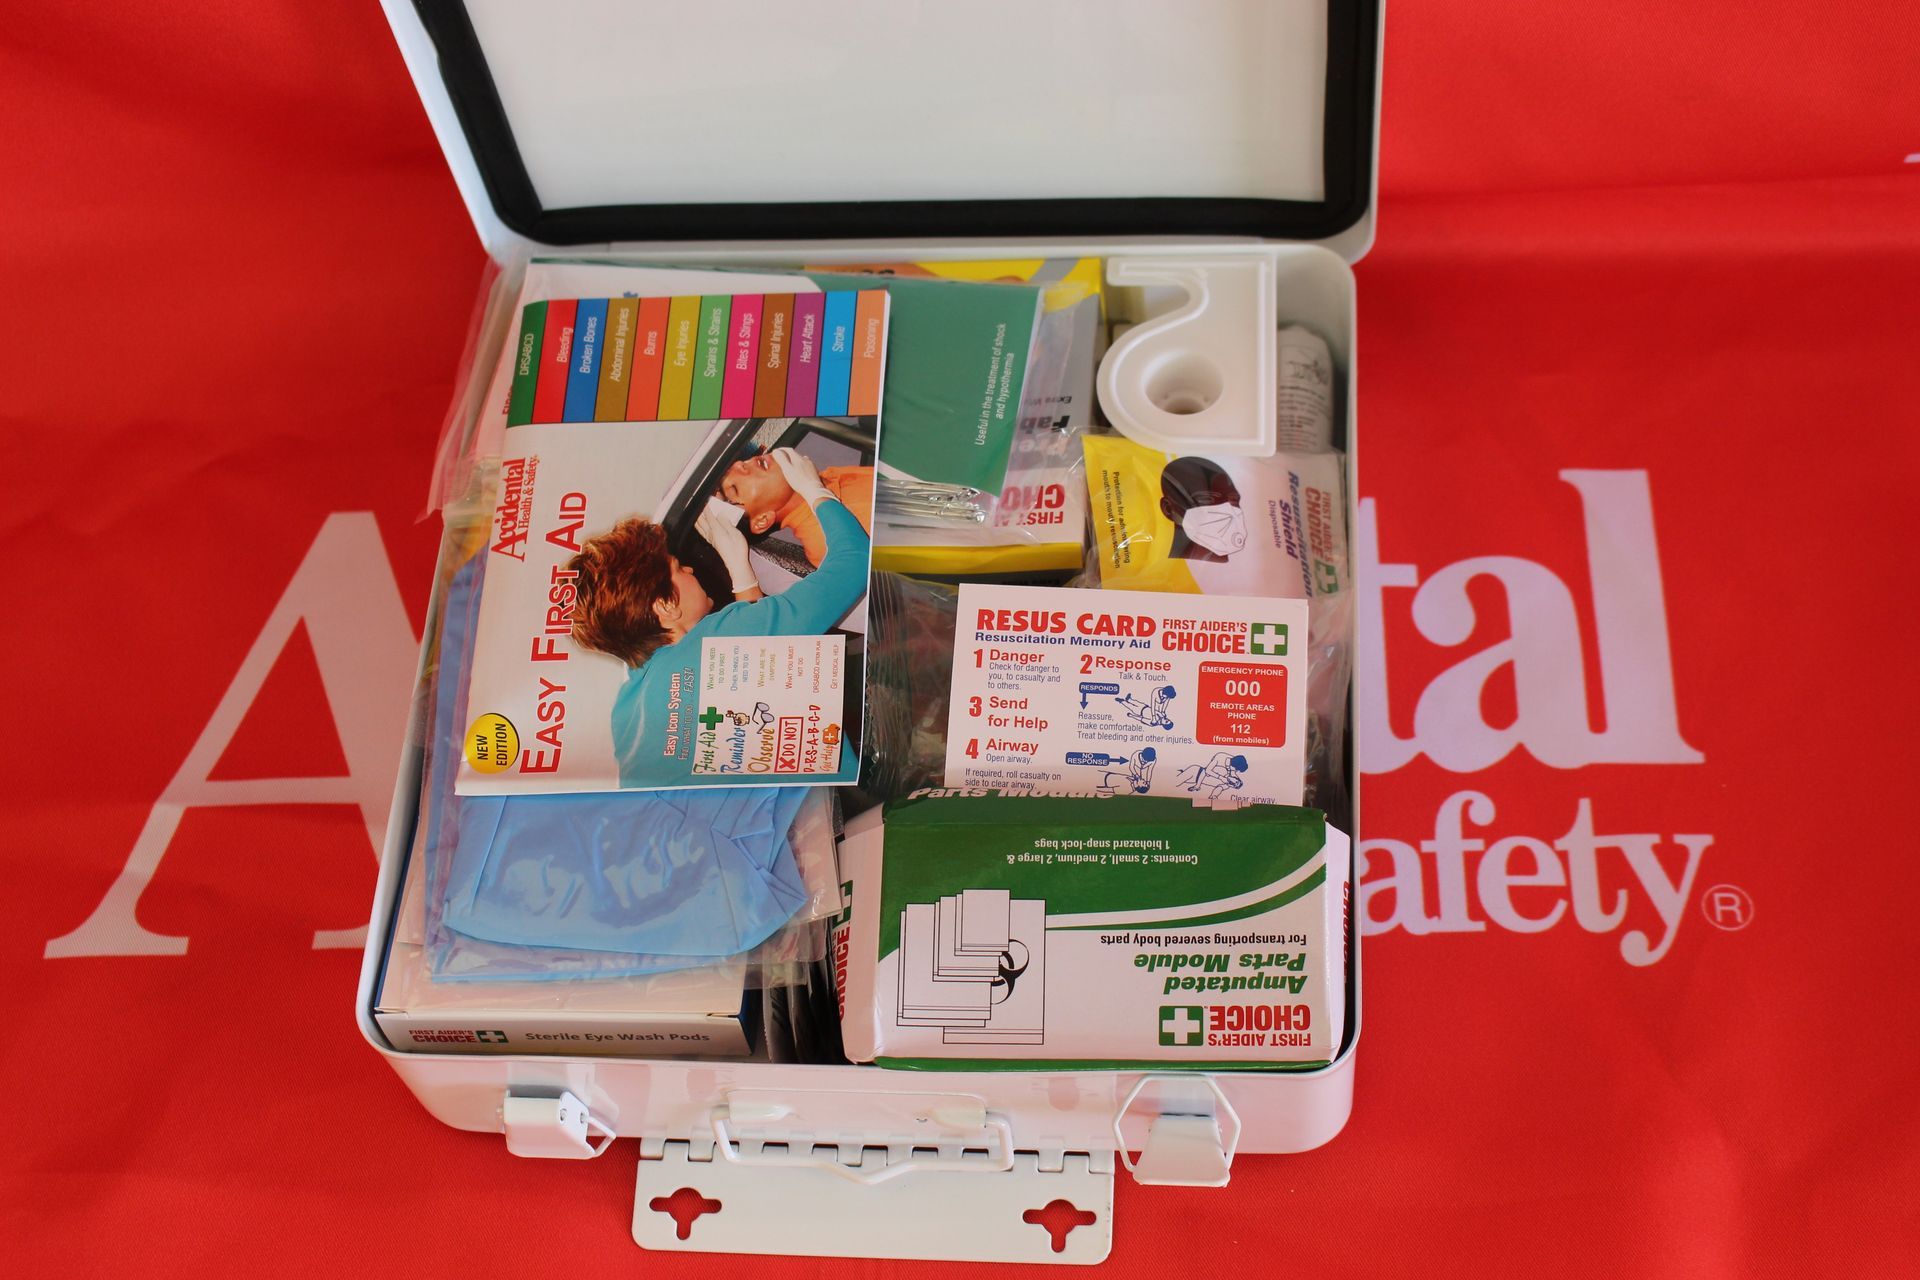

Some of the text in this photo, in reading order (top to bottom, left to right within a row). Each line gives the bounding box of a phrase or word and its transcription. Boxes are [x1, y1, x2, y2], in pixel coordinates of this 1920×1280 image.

[556, 327, 574, 363] Bleeding
[579, 316, 597, 374] Broken Bones
[610, 307, 630, 382] Abdominal Injuries
[643, 331, 657, 356] Burns
[674, 320, 690, 366] Eye Injuries
[704, 308, 722, 378] Sprains & Strains
[736, 313, 754, 370] Bites & Stings
[767, 312, 784, 369] Spinal Injuries
[800, 313, 815, 363] Heart Attack
[832, 326, 845, 352] Stroke
[863, 318, 880, 359] Poisoning
[519, 333, 535, 376] DRSABCD
[974, 323, 1006, 446] Useful in the treatment of shock
[994, 352, 1015, 420] and hypothermia
[522, 487, 534, 495] &
[490, 457, 529, 562] Accidental
[518, 495, 532, 530] Health
[1322, 491, 1331, 520] FIRST
[1268, 500, 1281, 549] Disposable
[1279, 499, 1299, 560] Shield
[1288, 470, 1312, 598] Resuscitation
[1305, 487, 1324, 559] CHOICE
[519, 491, 587, 774] EASY FIRST AID
[976, 609, 1157, 637] RESUS CARD
[1162, 619, 1247, 632] FIRST AIDER'S
[975, 632, 1151, 649] Resuscitation Memory Aid
[1161, 631, 1246, 654] CHOICE
[973, 648, 1045, 668] 1 Danger
[989, 662, 1060, 674] Check for danger to
[1080, 654, 1171, 674] 2 Response
[988, 673, 1061, 683] you, to casualty and
[1118, 671, 1168, 682] Talk & Touch.
[1201, 666, 1284, 676] EMERGENCY PHONE
[996, 682, 1021, 690] others.
[1080, 684, 1118, 692] RESPONDS
[1225, 680, 1261, 697] 000
[663, 673, 682, 756] Easy Icon System
[969, 696, 1028, 717] 3 Send
[1078, 711, 1114, 722] Reassure,
[1210, 702, 1275, 712] REMOTE AREAS
[1227, 712, 1257, 720] PHONE
[987, 715, 1049, 732] for Help
[1077, 722, 1145, 733] make comfortable.
[1230, 724, 1251, 735] 112
[476, 734, 489, 760] NEW
[495, 723, 507, 766] EDITION
[782, 721, 798, 756] DO NOT
[803, 704, 821, 772] D-R-S-A-B-C-D
[965, 738, 1039, 759] 4 Airway
[1077, 731, 1194, 745] Treat bleeding and other injuries.
[1213, 735, 1269, 746] (from mobiles)
[692, 731, 720, 773] First Aid
[720, 727, 746, 773] Reminder
[747, 728, 775, 773] Observe
[985, 753, 1033, 765] Open airway.
[1067, 758, 1108, 766] RESPONSE
[965, 768, 972, 776] If
[972, 769, 1004, 778] required,
[1006, 770, 1018, 778] roll
[1019, 771, 1050, 781] casualty
[965, 778, 981, 787] side
[991, 779, 1009, 788] clear
[1010, 781, 1037, 790] airway.
[1034, 838, 1170, 850] 1 biohazard snap-lock bags
[1006, 853, 1198, 865] Contents: 2 small, 2 medium, 2 large &
[1360, 790, 1714, 967] afety
[1100, 933, 1307, 946] For transporting severed body parts
[1134, 952, 1306, 973] Parts Module
[1163, 971, 1308, 995] Amputated
[1209, 1004, 1311, 1031] CHOICE
[412, 1034, 477, 1043] CHOICE
[525, 1032, 710, 1043] Sterile Eye Wash Pods
[1208, 1033, 1312, 1047] FIRST AIDER'S
